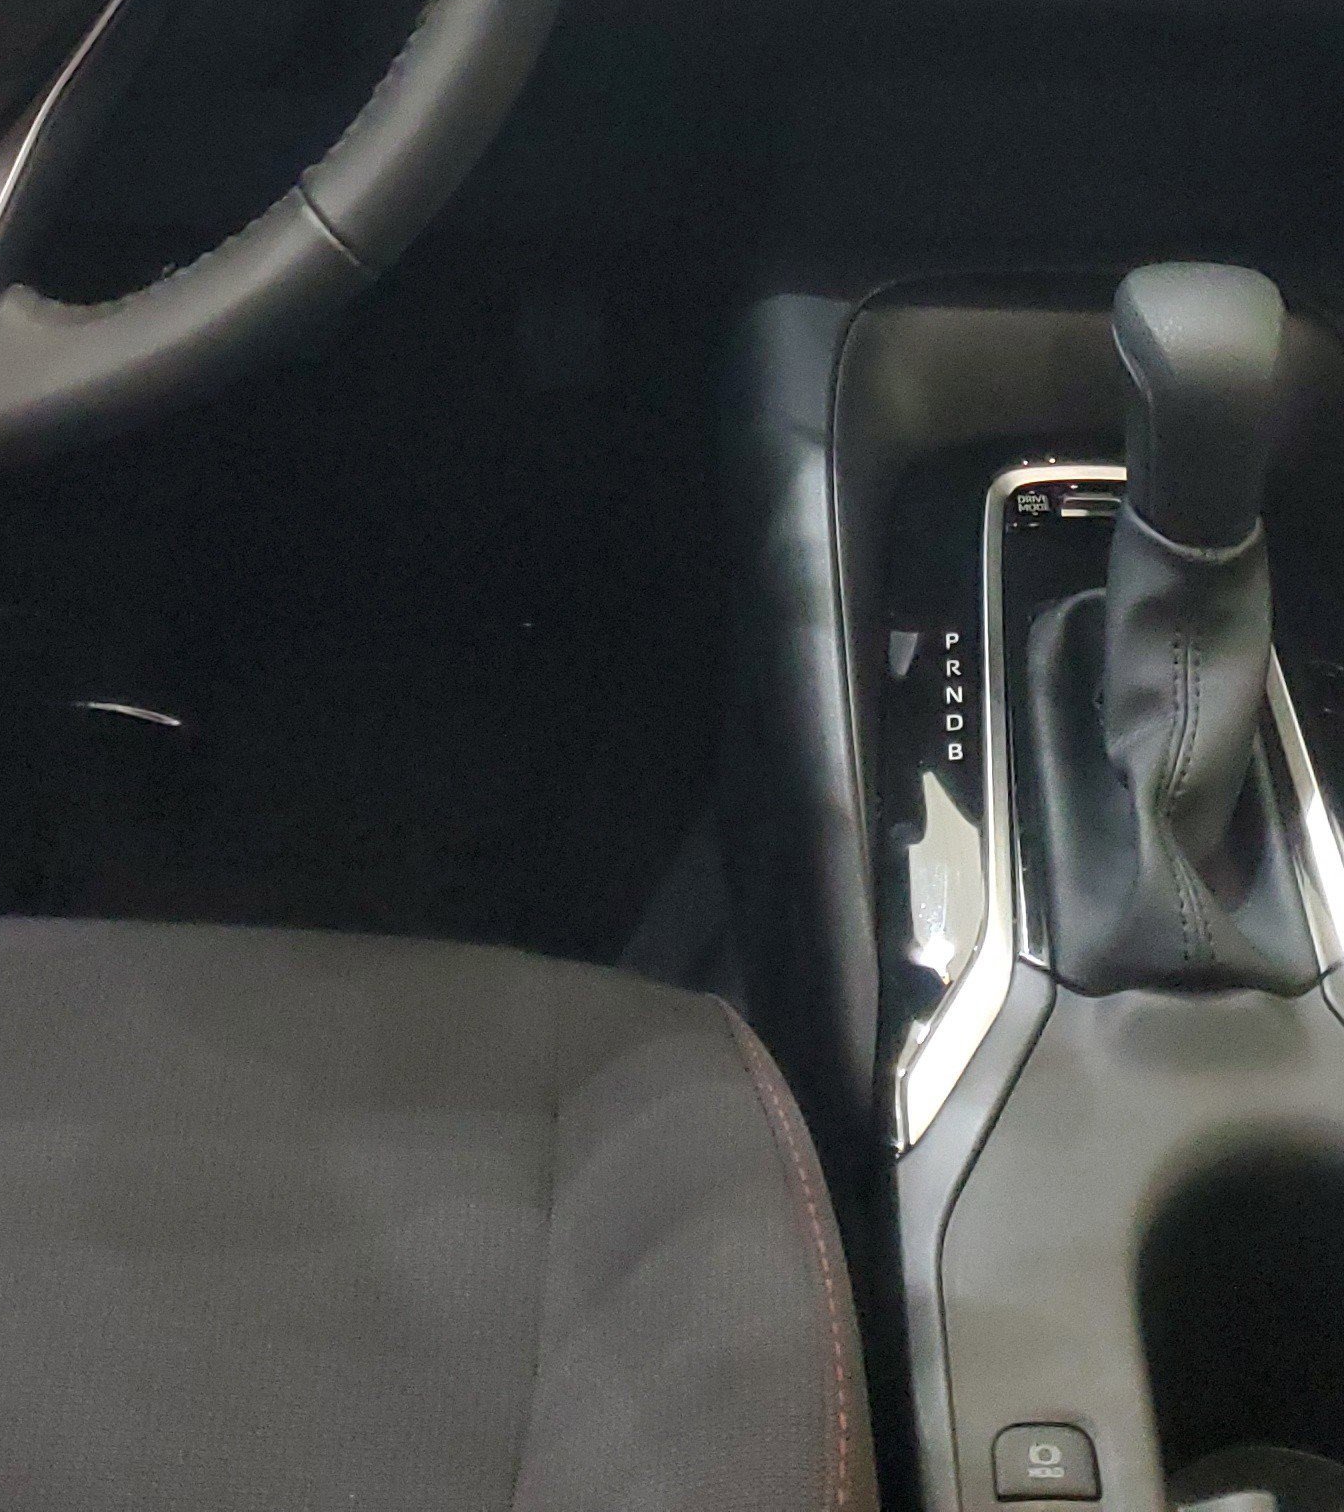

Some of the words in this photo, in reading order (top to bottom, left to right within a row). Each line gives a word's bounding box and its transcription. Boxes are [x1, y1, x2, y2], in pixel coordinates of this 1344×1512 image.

[945, 632, 960, 650] P
[946, 659, 962, 677] R
[946, 685, 963, 705] N
[946, 714, 964, 732] D
[948, 743, 964, 761] B
